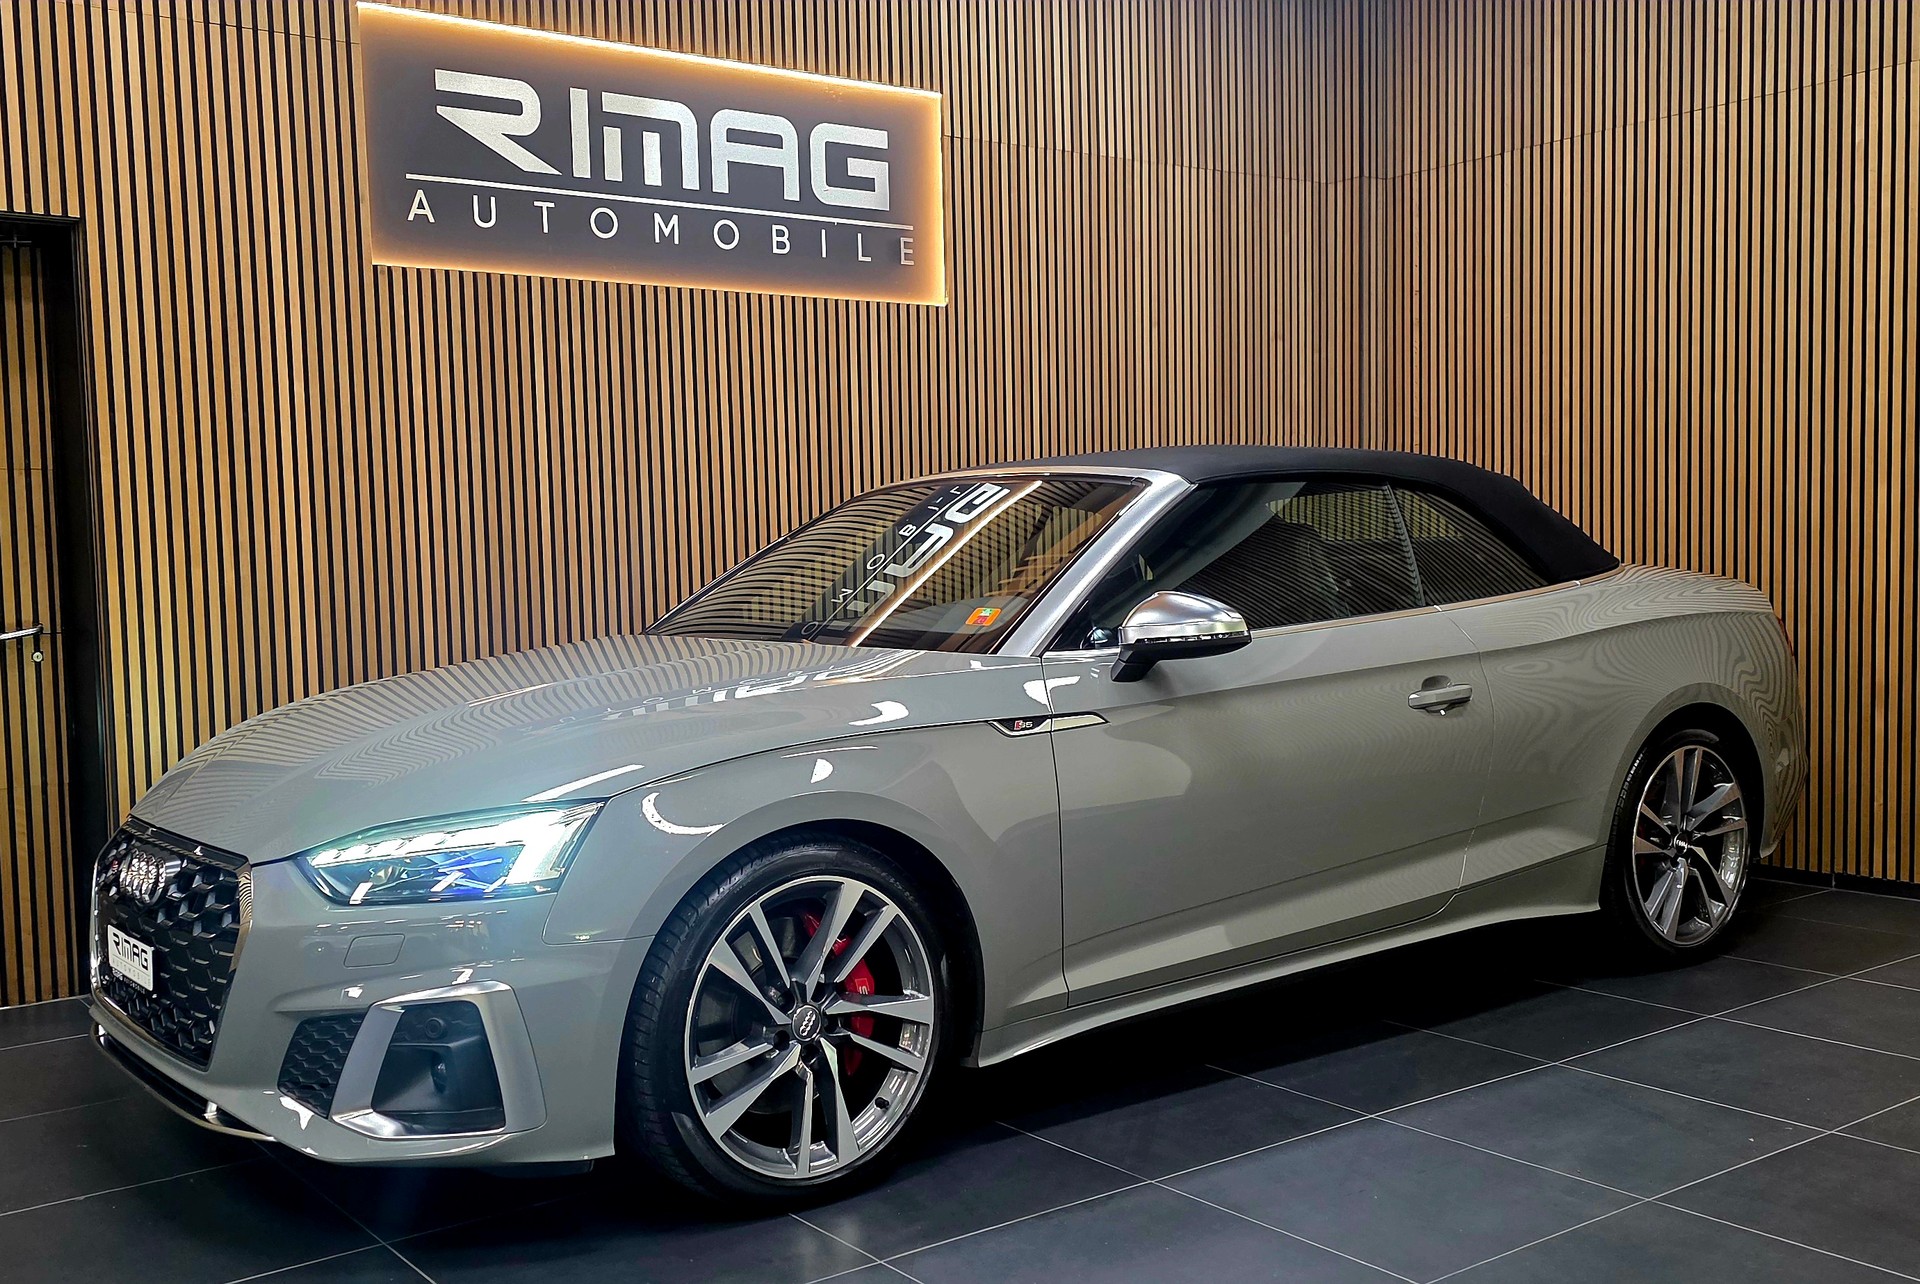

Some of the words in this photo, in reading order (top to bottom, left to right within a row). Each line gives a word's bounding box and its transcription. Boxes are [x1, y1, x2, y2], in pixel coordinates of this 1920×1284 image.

[434, 68, 890, 211] RIMAG
[406, 189, 915, 266] AUTOMOBILE
[112, 932, 148, 971] RIMAG
